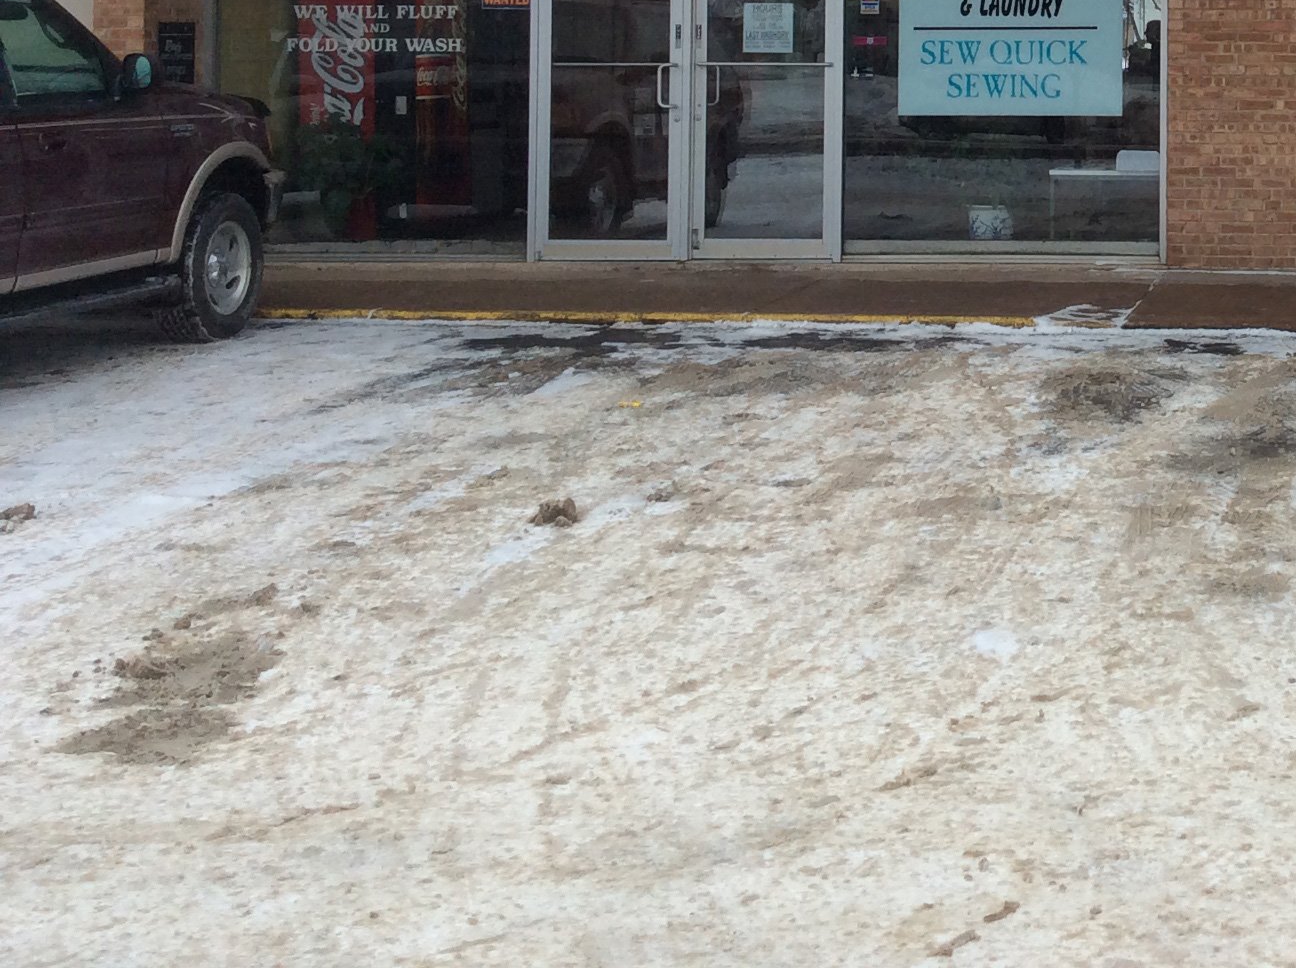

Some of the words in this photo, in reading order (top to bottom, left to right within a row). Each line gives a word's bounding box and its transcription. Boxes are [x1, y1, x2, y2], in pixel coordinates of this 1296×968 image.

[293, 4, 328, 20] WE
[335, 4, 390, 20] WILL
[396, 4, 460, 20] FLUFF
[286, 38, 338, 53] FOLD
[346, 38, 399, 53] YOUR
[404, 38, 464, 53] WASH
[920, 39, 982, 65] SEW
[989, 39, 1088, 66] QUICK
[946, 73, 1062, 99] SEWING
